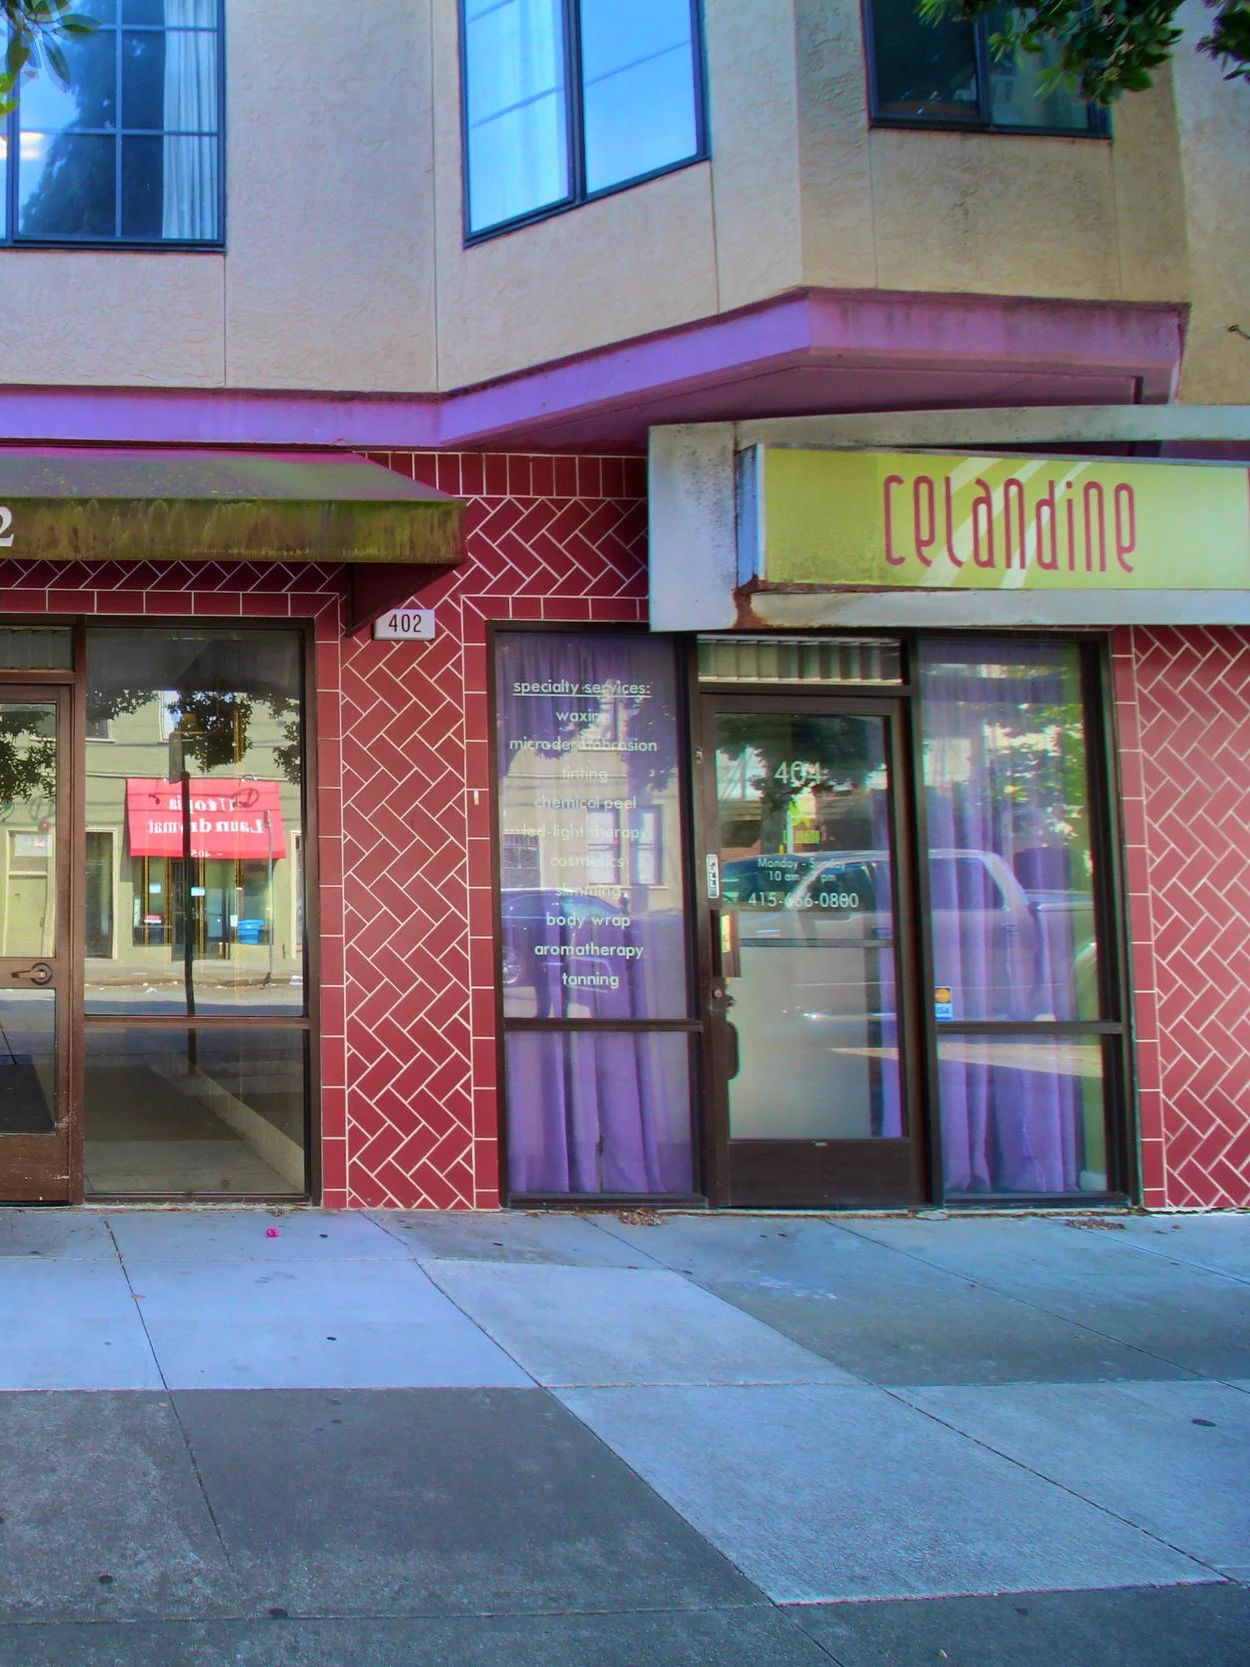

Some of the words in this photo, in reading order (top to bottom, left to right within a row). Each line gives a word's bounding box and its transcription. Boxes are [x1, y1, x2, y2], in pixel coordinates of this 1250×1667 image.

[388, 613, 422, 632] 402
[513, 679, 579, 694] specialty
[583, 680, 651, 695] services:
[555, 709, 611, 724] waxing
[773, 760, 823, 785] 404
[534, 794, 600, 809] chemical
[604, 796, 637, 814] peel
[757, 857, 798, 870] Monday
[769, 870, 782, 881] 10
[820, 874, 836, 883] pm
[545, 911, 584, 929] body
[591, 914, 631, 929] wrap
[534, 941, 644, 959] aromatherapy
[561, 971, 620, 988] tanning
